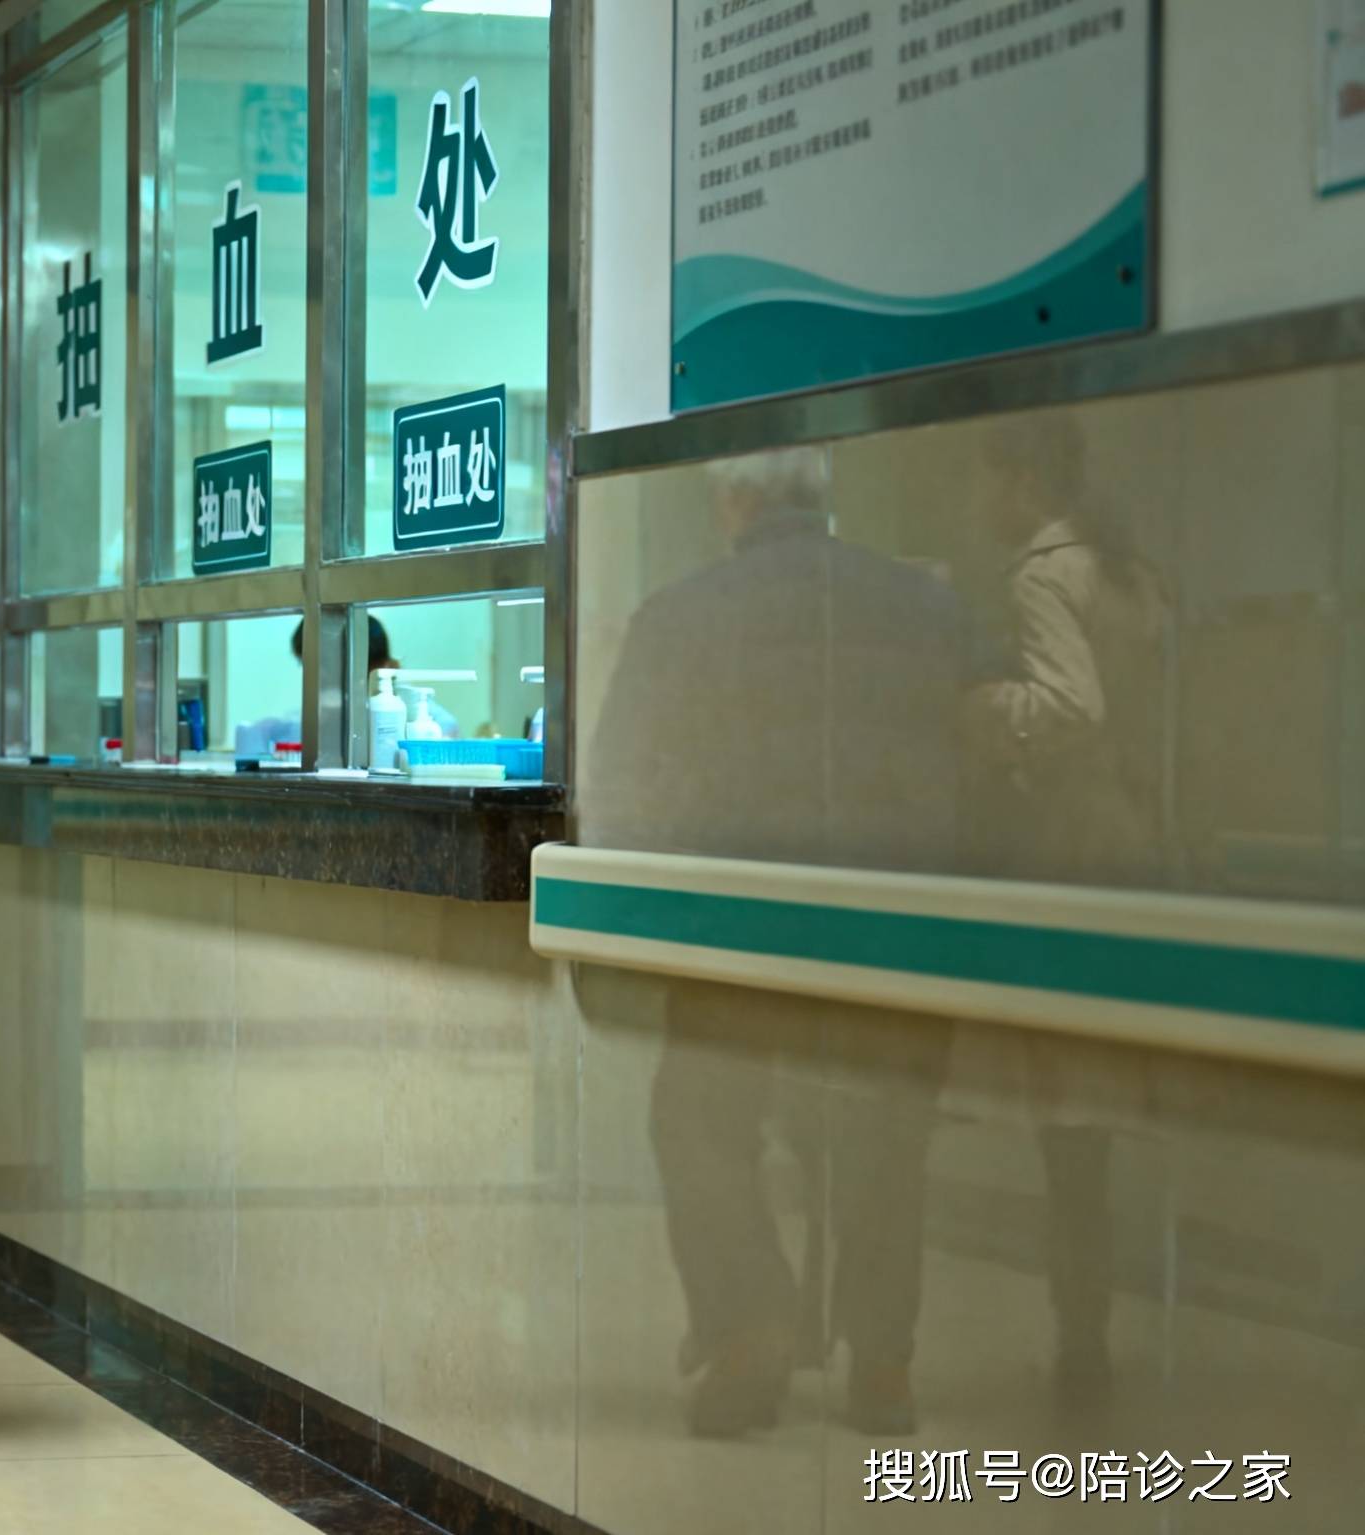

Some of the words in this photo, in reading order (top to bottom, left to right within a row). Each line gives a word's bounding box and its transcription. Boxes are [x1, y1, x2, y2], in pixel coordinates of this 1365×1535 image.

[197, 472, 266, 548] 抽血处
[401, 427, 496, 515] 抽血处
